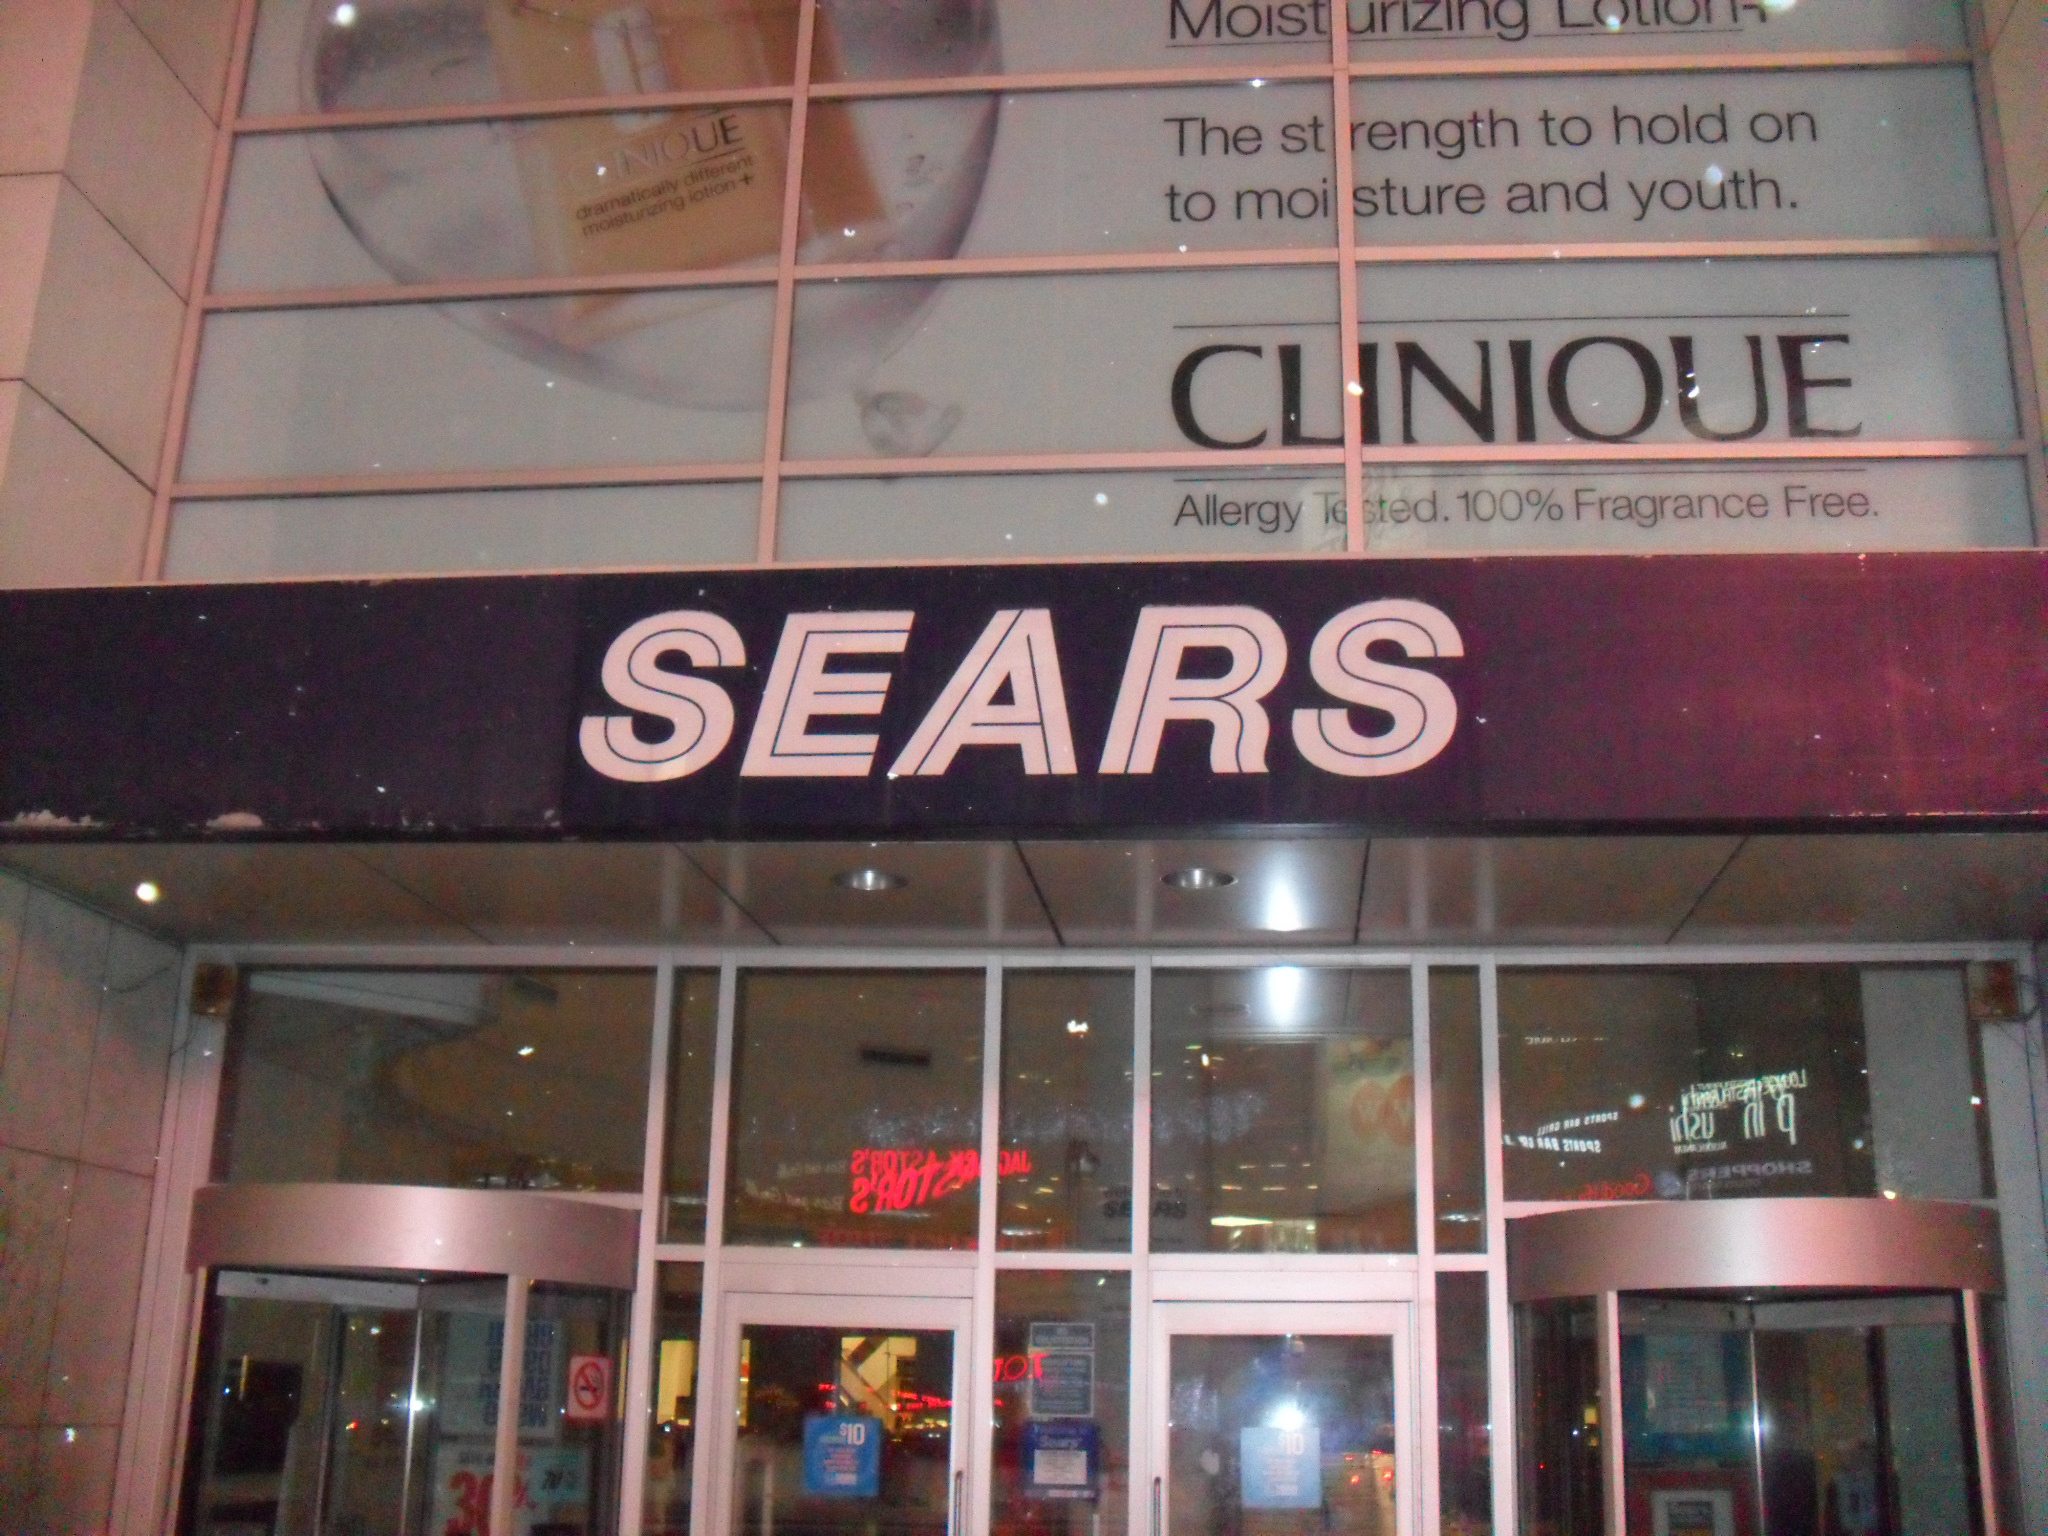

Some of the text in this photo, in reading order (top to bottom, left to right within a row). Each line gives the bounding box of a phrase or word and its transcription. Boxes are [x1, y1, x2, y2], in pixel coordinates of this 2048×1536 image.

[1169, 0, 1529, 42] Moisturizing
[1165, 104, 1818, 161] The strength to hold on
[575, 154, 754, 221] dramatically different
[1165, 168, 1799, 222] to moisture and youth.
[582, 195, 686, 238] moisturizing
[1170, 333, 1863, 451] CLINIQUE
[1173, 484, 1880, 534] Allergy Tested. 100% Fragrance Free.
[578, 598, 1465, 784] SEARS
